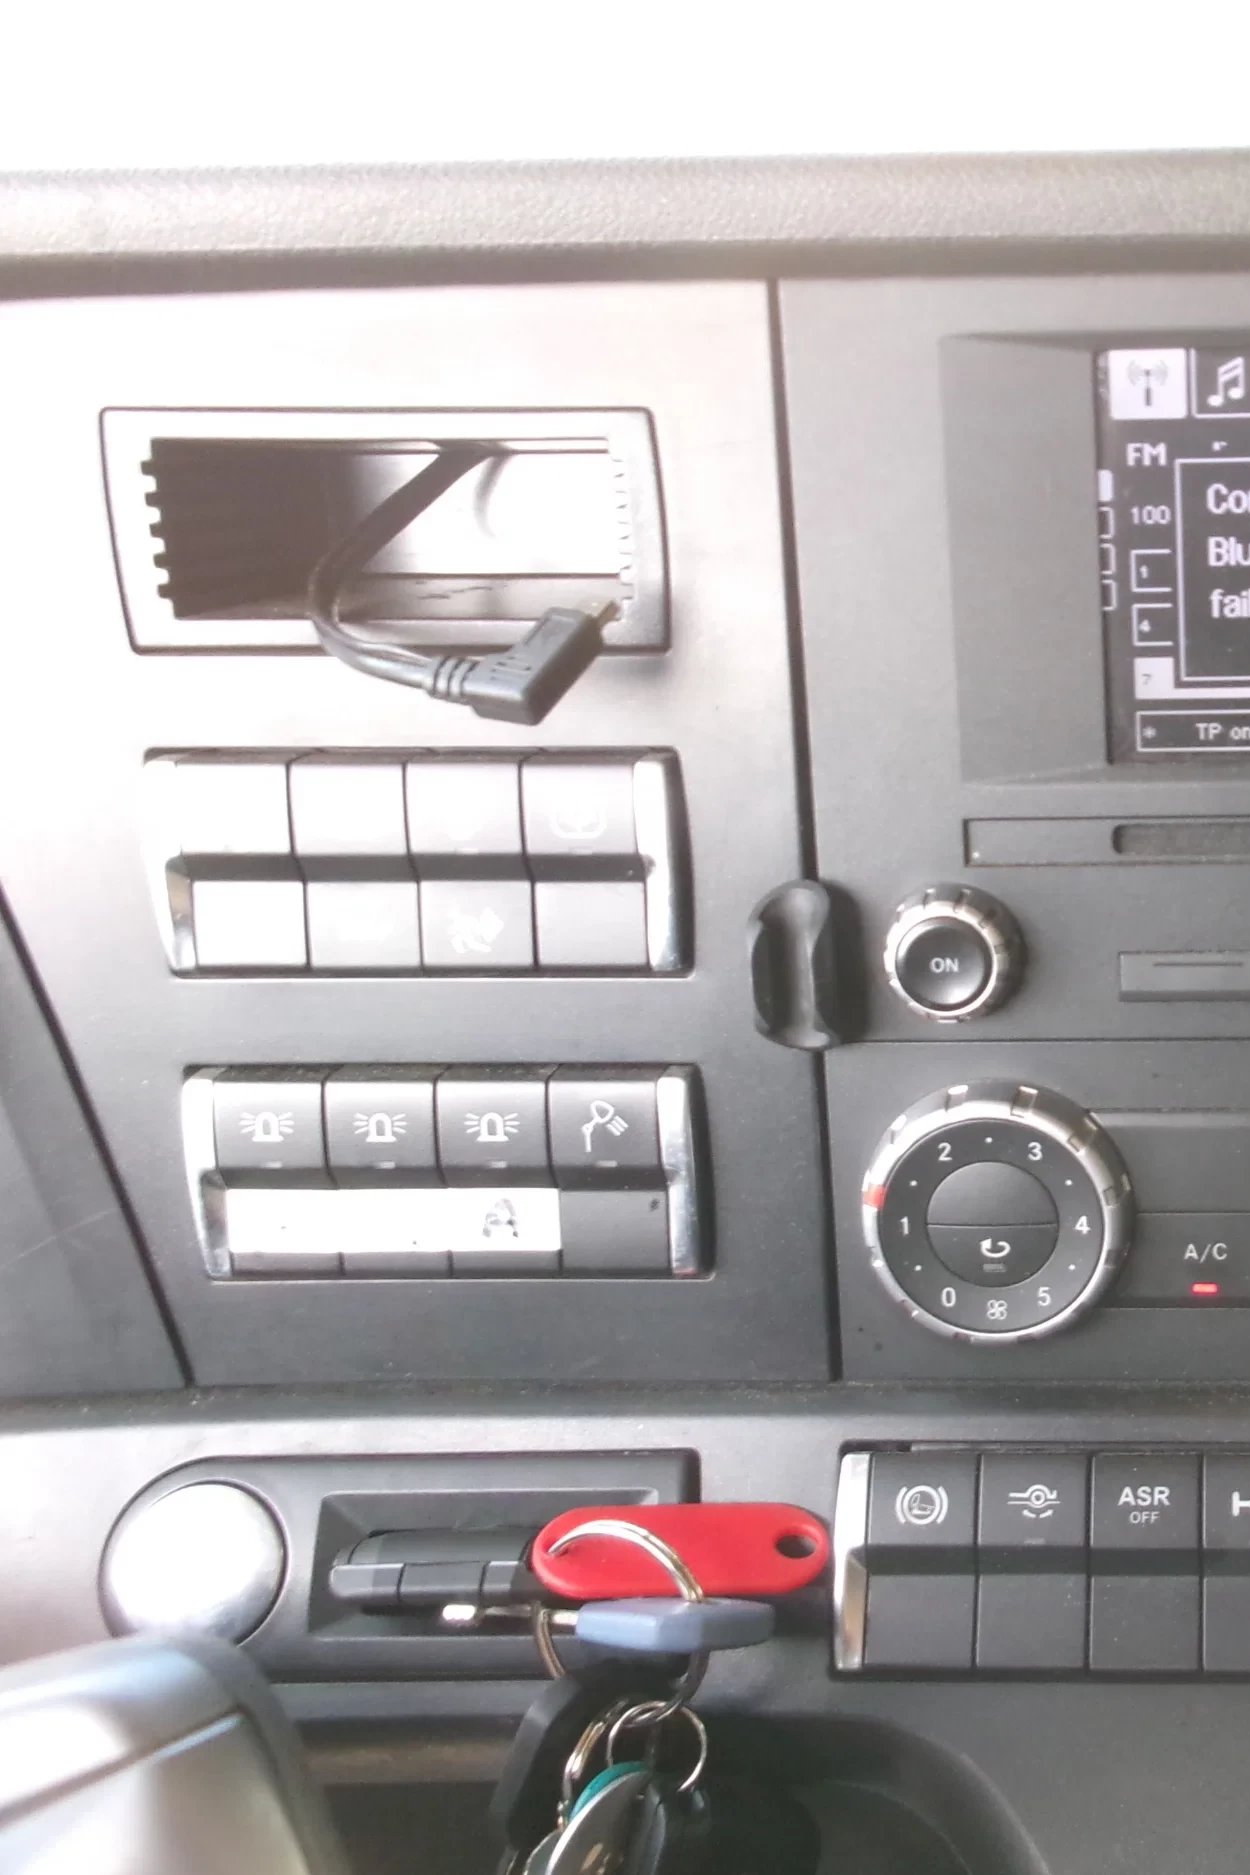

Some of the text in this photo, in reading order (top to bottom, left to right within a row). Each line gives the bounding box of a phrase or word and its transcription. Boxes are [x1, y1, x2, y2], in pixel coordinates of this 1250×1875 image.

[1126, 442, 1168, 467] FM
[1130, 505, 1172, 525] 100
[1196, 723, 1221, 740] TP
[931, 957, 959, 974] ON
[938, 1142, 953, 1162] 2
[1028, 1142, 1043, 1161] 3
[900, 1216, 909, 1236] 1
[1075, 1215, 1091, 1234] 4
[1183, 1243, 1228, 1262] A/C
[941, 1287, 956, 1307] 0
[1038, 1287, 1051, 1306] 5
[1117, 1485, 1170, 1506] ASR
[1129, 1511, 1159, 1524] OFF
